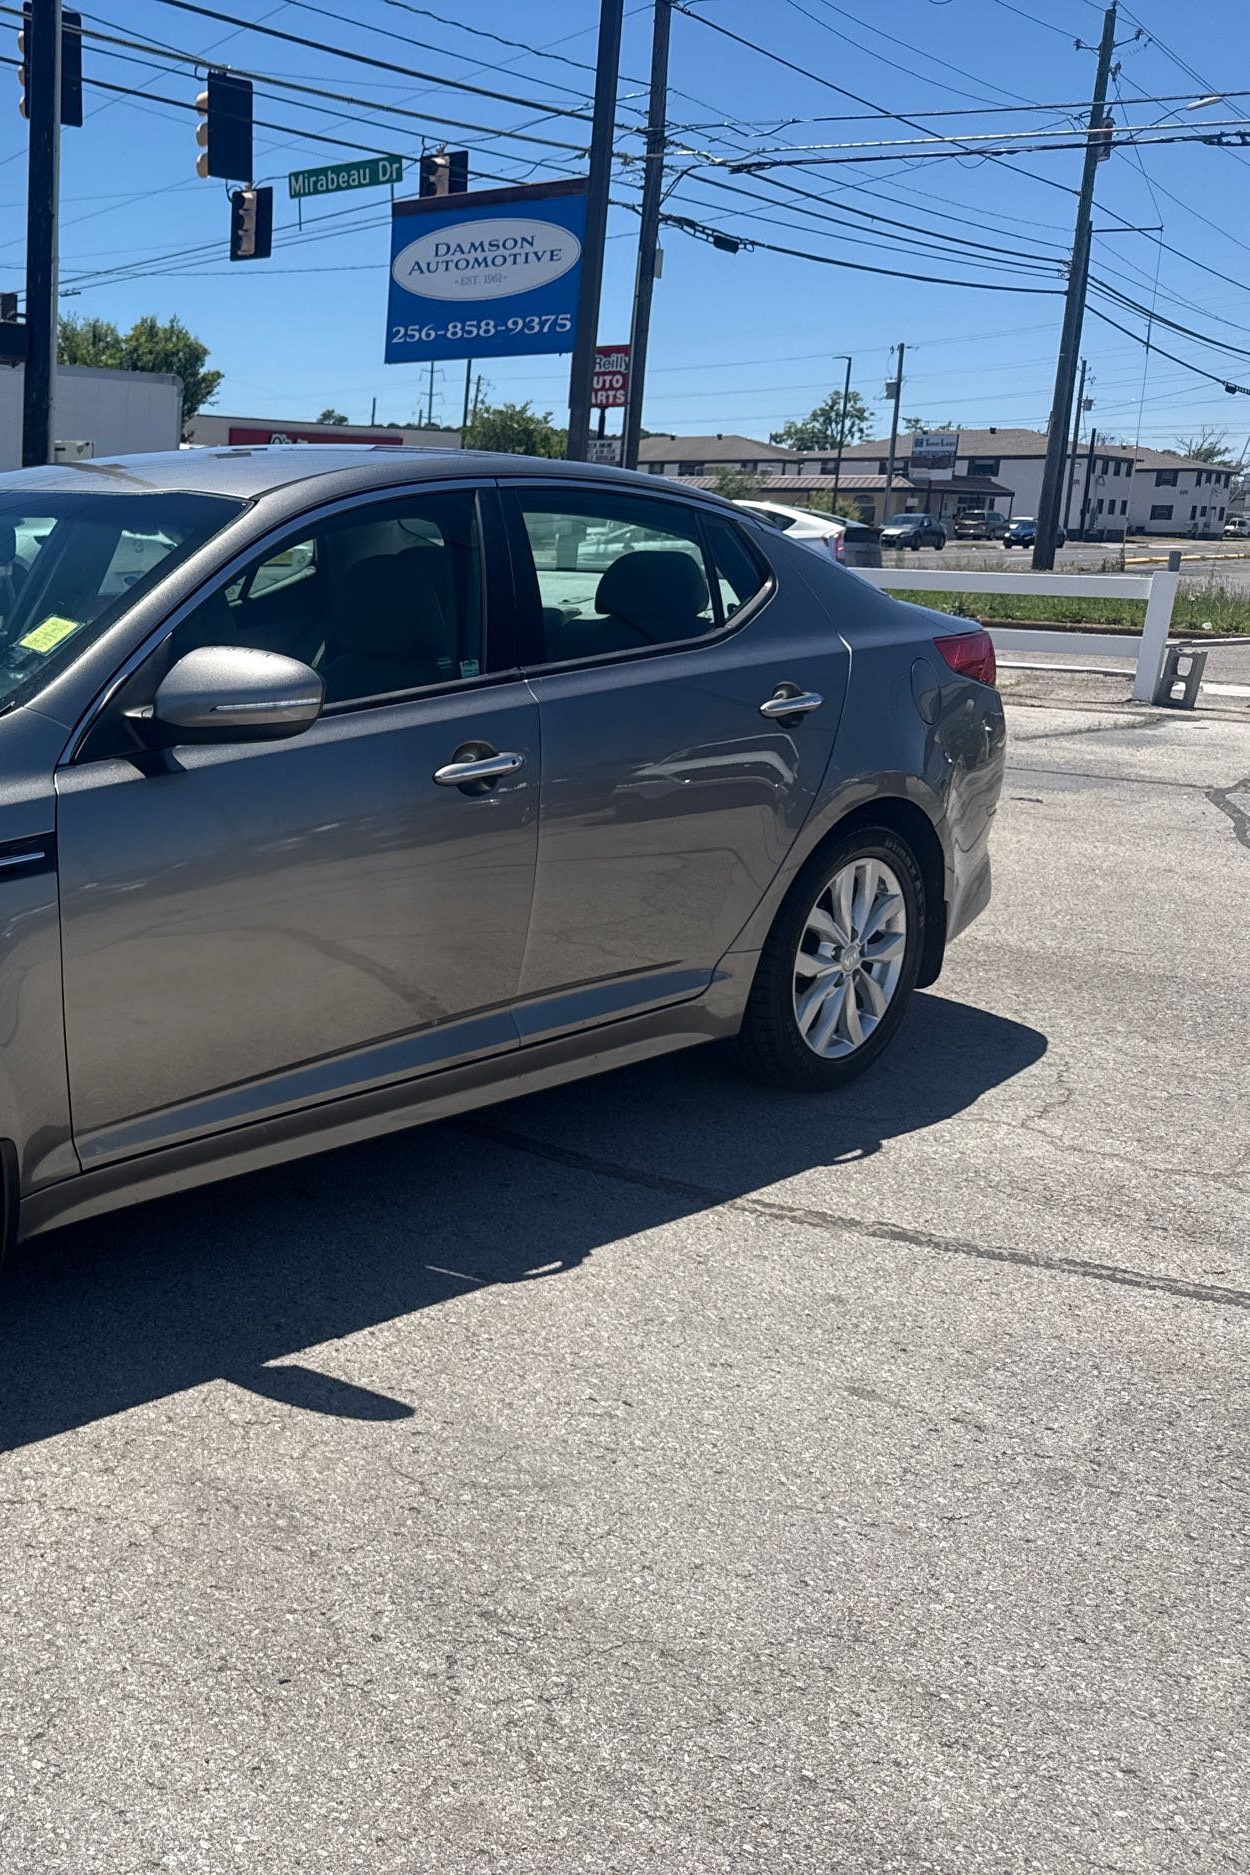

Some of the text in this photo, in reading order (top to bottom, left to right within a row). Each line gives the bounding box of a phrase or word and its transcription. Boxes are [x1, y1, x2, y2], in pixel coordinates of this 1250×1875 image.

[291, 160, 400, 195] Mirabeau Dr
[433, 235, 536, 258] DAMSON
[407, 248, 563, 276] AUTOMOTIVE
[391, 313, 572, 344] 256-858-9375
[594, 353, 630, 373] Reilly
[592, 374, 623, 389] UTO
[592, 389, 626, 405] RTS
